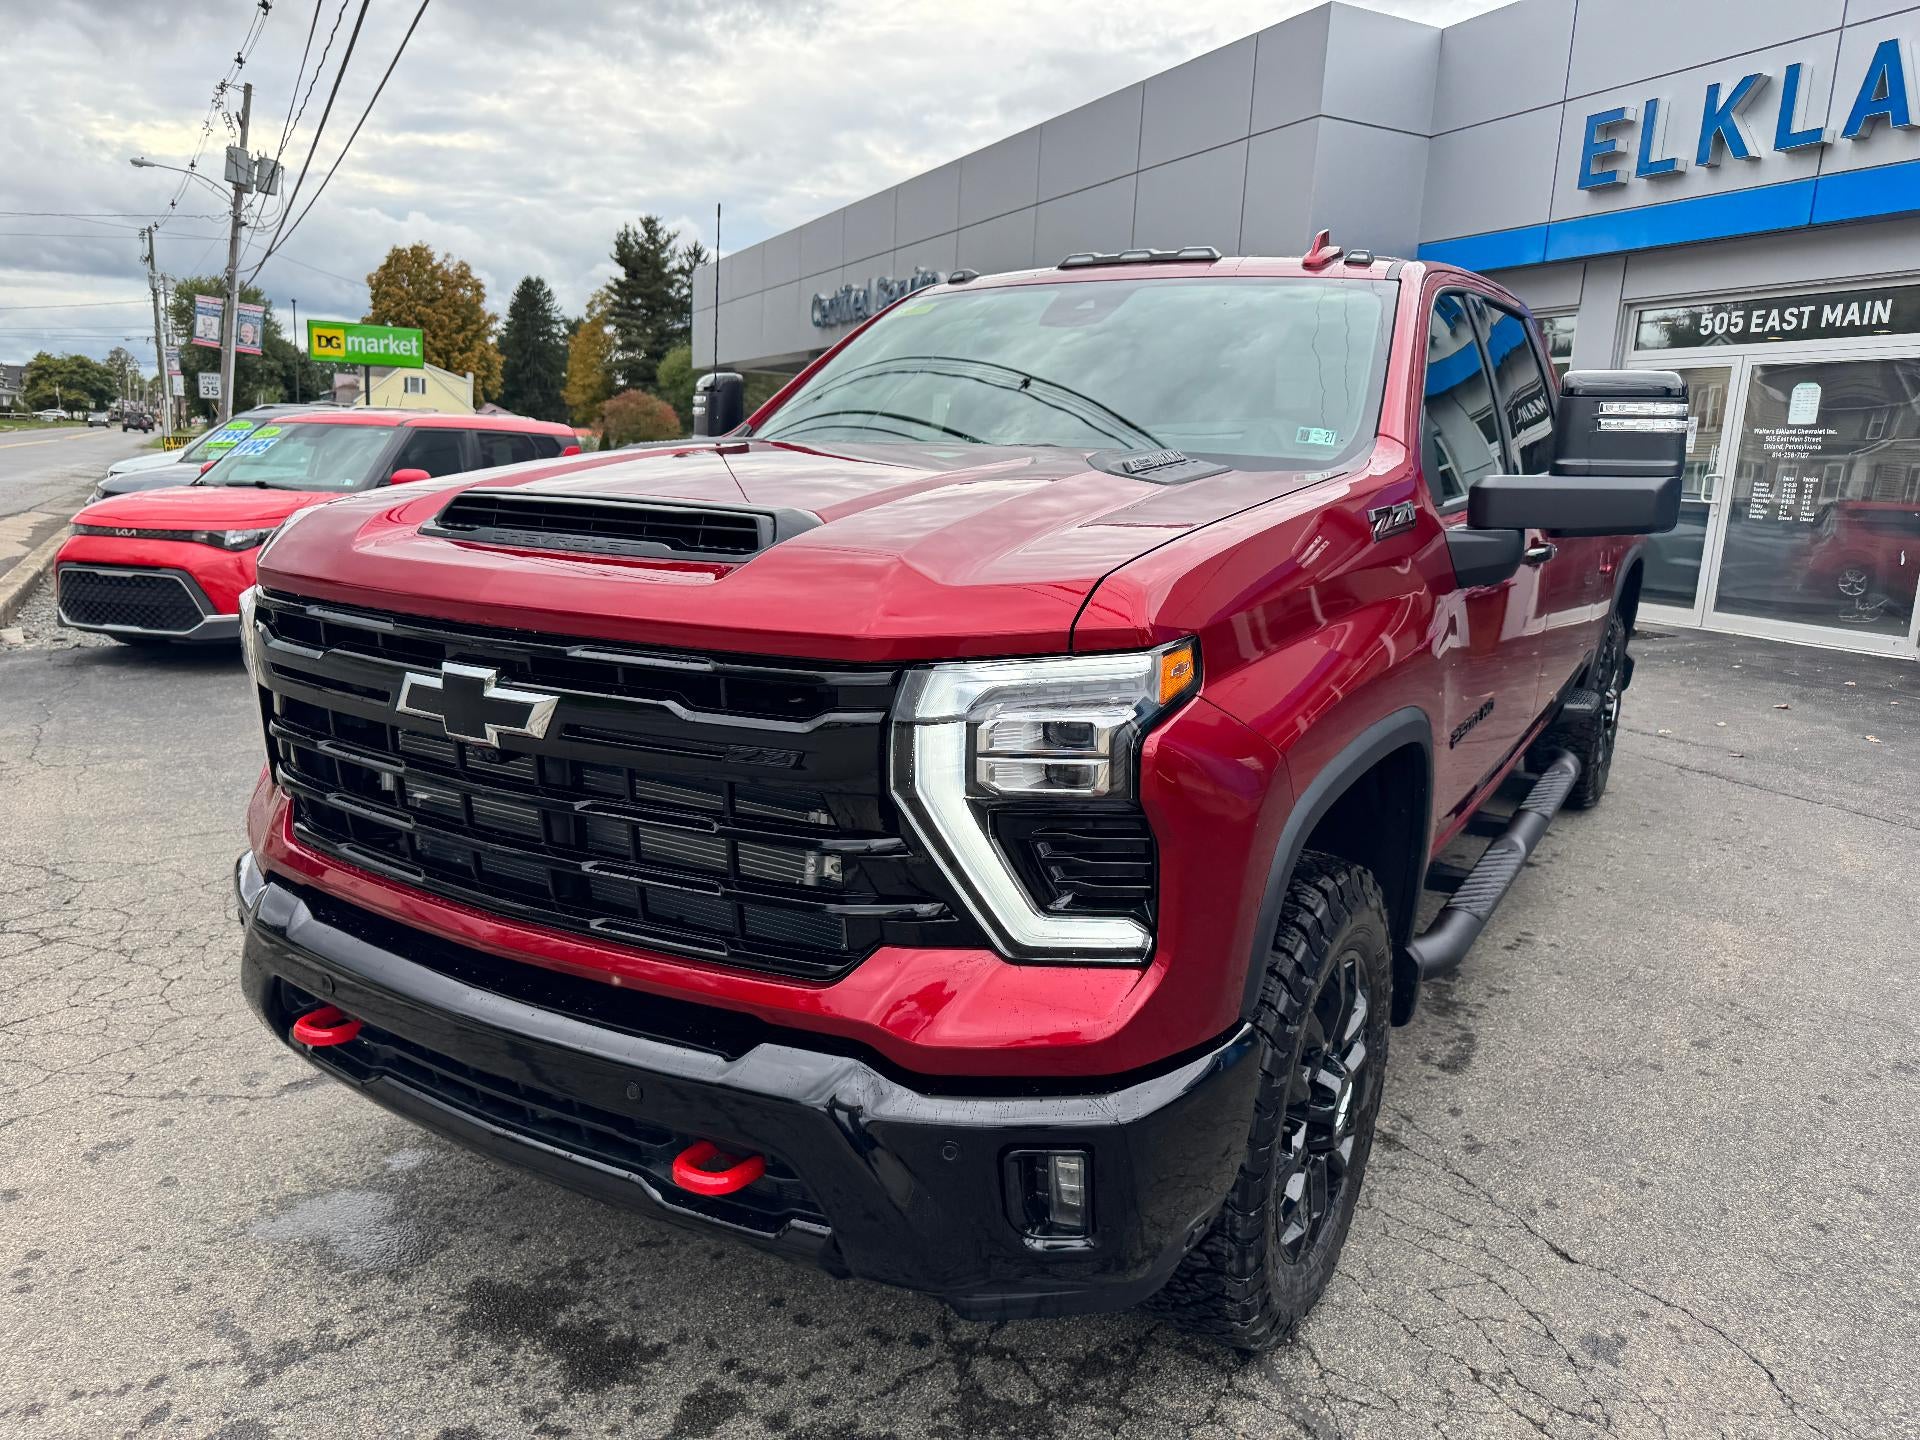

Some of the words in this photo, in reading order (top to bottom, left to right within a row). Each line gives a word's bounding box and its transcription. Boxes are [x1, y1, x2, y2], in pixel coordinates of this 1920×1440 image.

[1577, 37, 1916, 191] ELKLA
[812, 278, 872, 328] Certified
[1699, 311, 1745, 336] 505
[1750, 305, 1816, 333] EAST
[1820, 298, 1893, 328] MAIN
[316, 335, 342, 349] DG
[346, 334, 420, 357] market
[202, 386, 219, 396] 35
[1324, 431, 1335, 444] 27
[1784, 443, 1822, 451] Pennsylvania
[115, 528, 137, 537] KIA
[493, 529, 643, 552] CHEVROLET
